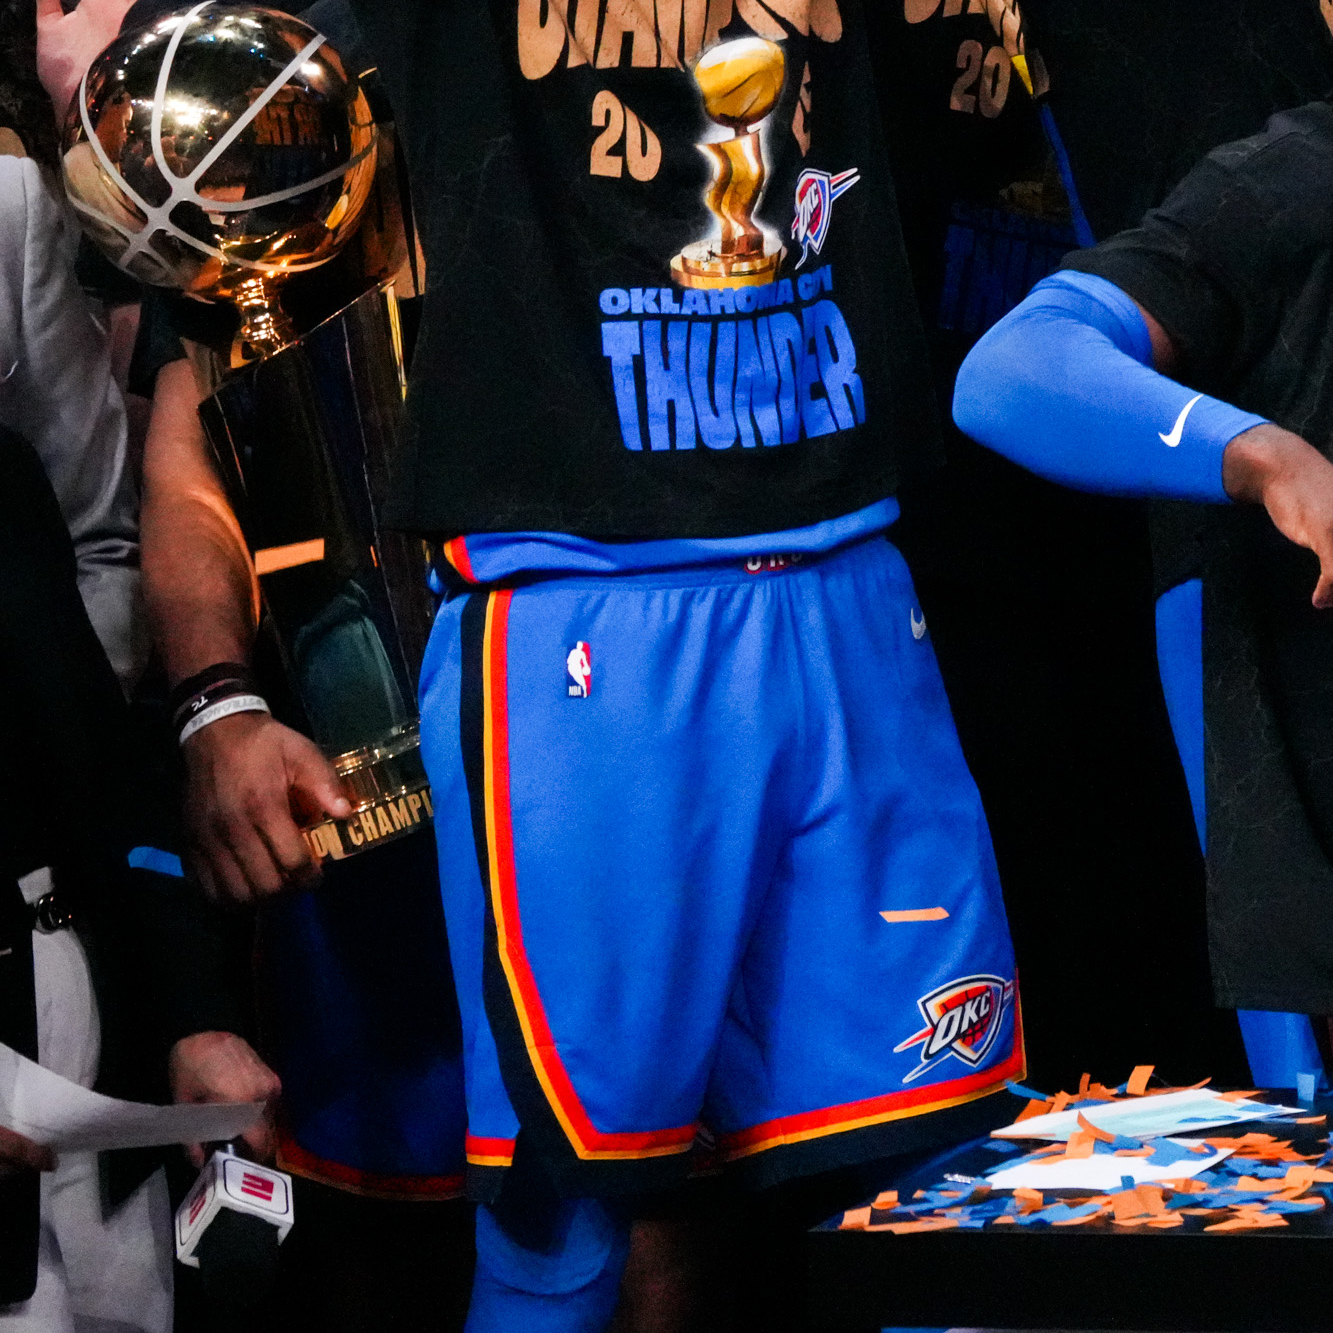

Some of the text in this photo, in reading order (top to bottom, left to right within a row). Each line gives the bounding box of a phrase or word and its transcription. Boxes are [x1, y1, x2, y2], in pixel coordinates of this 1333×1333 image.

[950, 40, 1011, 119] 20
[589, 89, 662, 182] 20
[600, 277, 794, 316] OKLAHOMA
[600, 299, 866, 452] THUNDER
